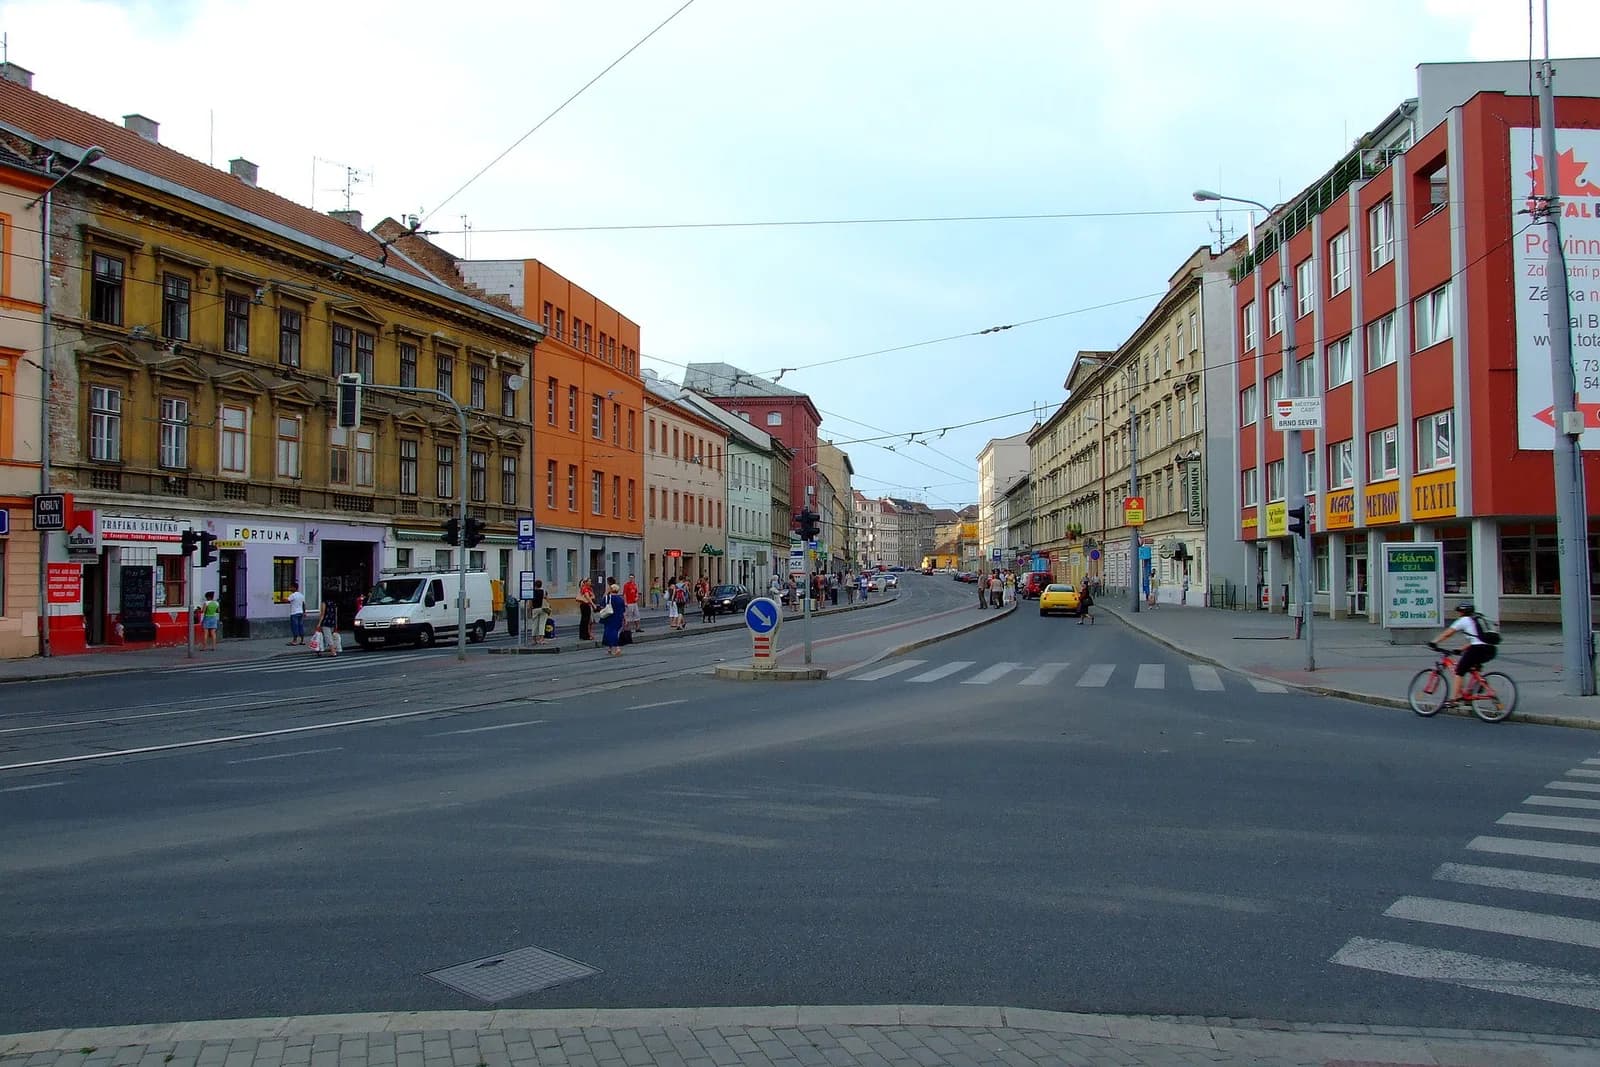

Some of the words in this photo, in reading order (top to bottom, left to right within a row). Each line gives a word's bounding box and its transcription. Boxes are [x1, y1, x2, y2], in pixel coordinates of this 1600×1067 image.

[1279, 419, 1297, 427] BRNO
[1298, 418, 1318, 426] SEVER
[1190, 466, 1201, 518] STAROPRAMEN
[40, 500, 60, 511] OBUV
[37, 514, 62, 525] TEXTIL
[102, 519, 137, 531] TRAFIKA
[234, 526, 291, 541] FORTUNA
[1390, 553, 1433, 562] Lékárna
